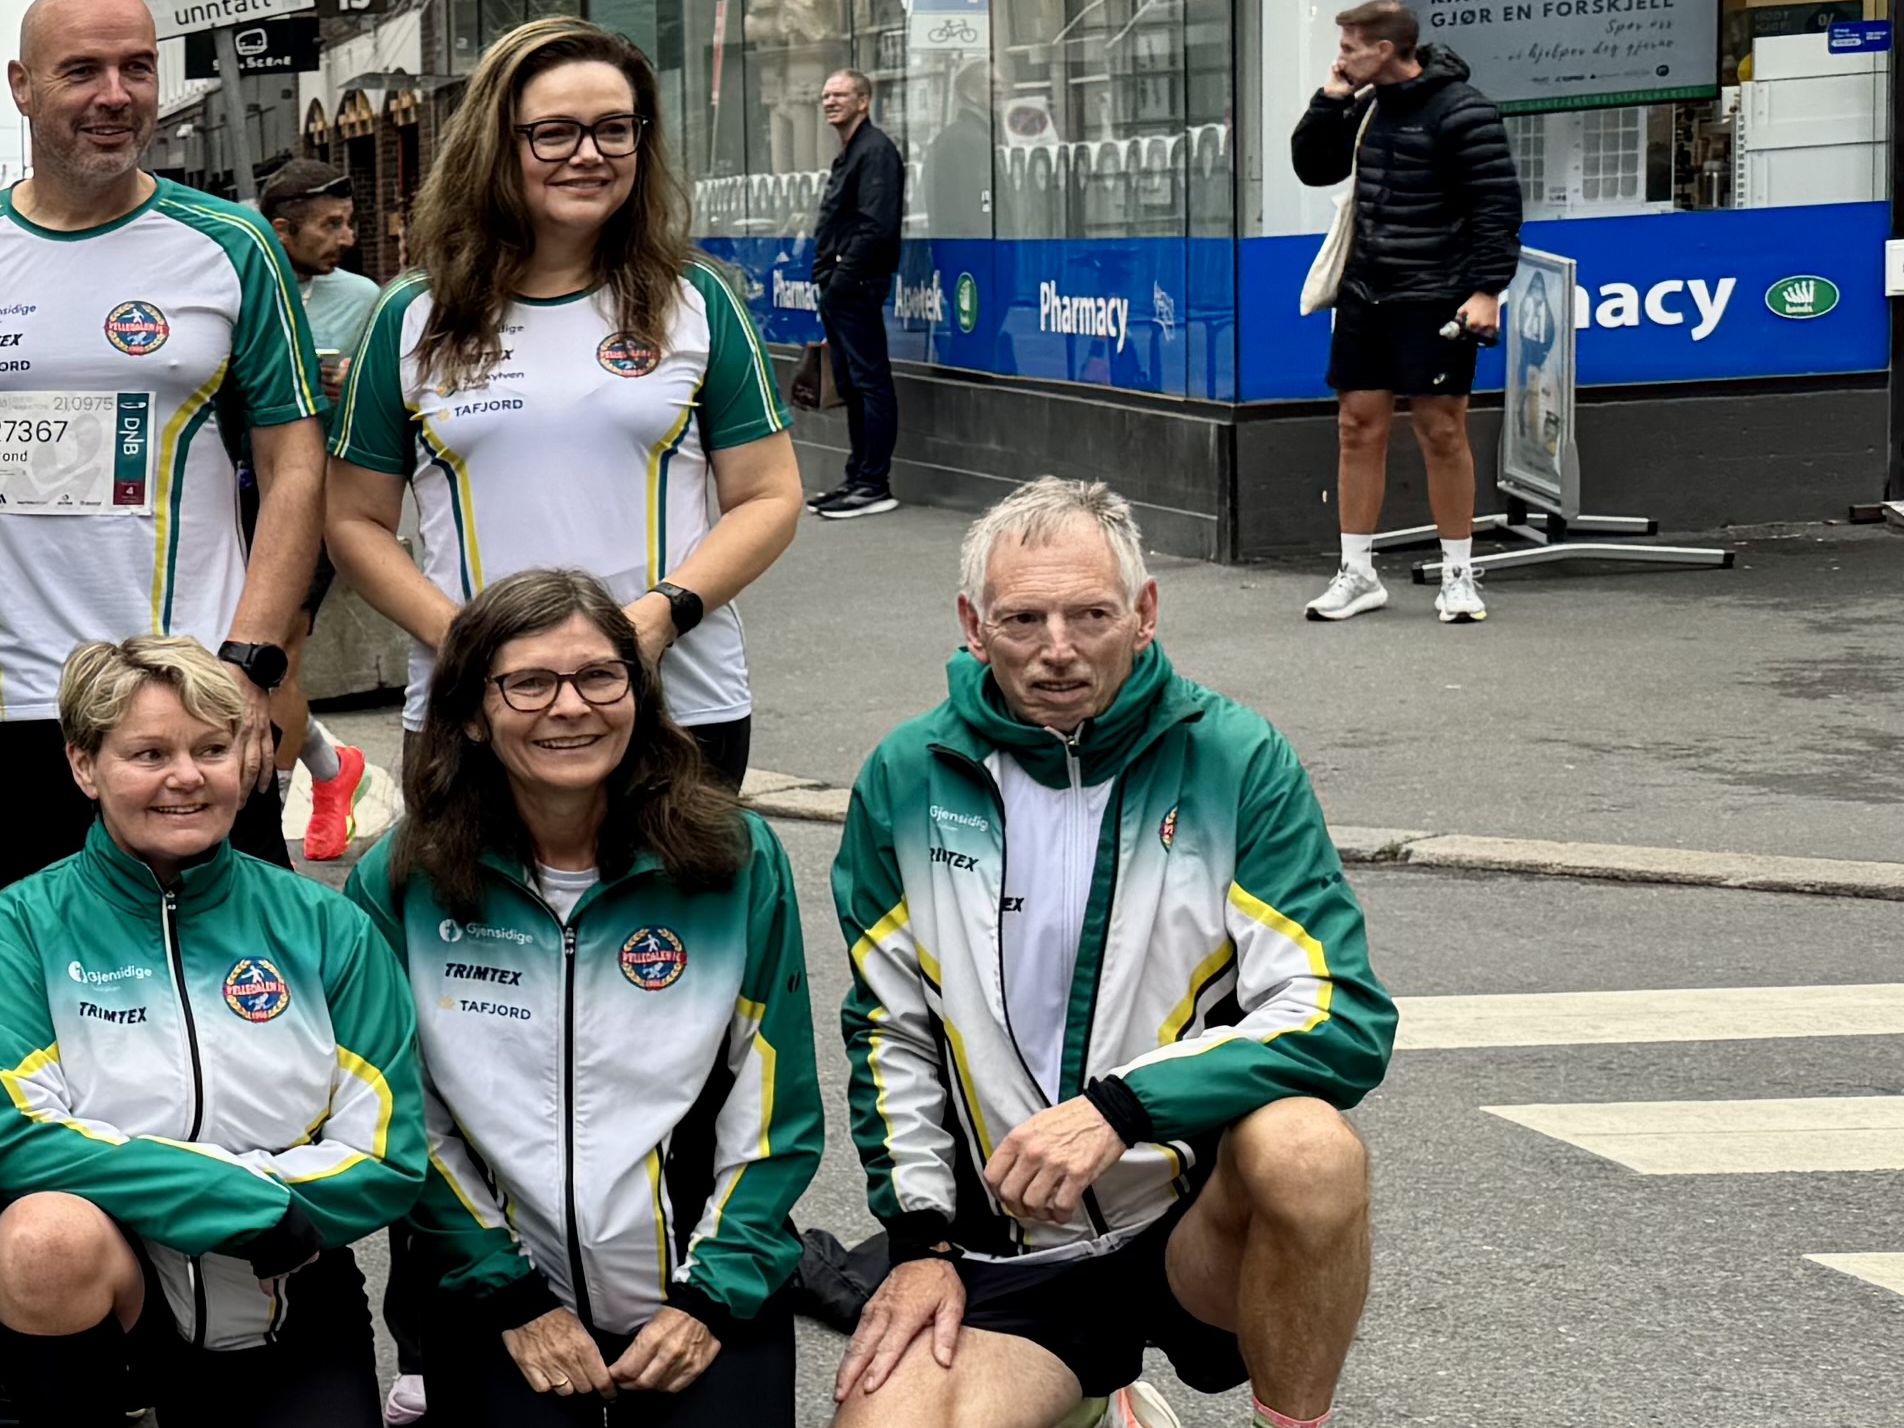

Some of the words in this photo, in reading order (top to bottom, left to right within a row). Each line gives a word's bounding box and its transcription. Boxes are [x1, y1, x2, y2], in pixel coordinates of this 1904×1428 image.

[1431, 9, 1494, 29] GJØR
[1503, 4, 1533, 22] EN
[894, 269, 944, 324] Apotek
[1040, 281, 1129, 354] Pharmacy
[454, 399, 524, 418] TAFJORD
[119, 417, 145, 455] DNB
[466, 922, 534, 945] Gjensidige
[444, 963, 523, 986] TRIMTEX
[79, 1002, 148, 1024] TRIMTEX
[460, 1000, 532, 1020] TAFJORD
